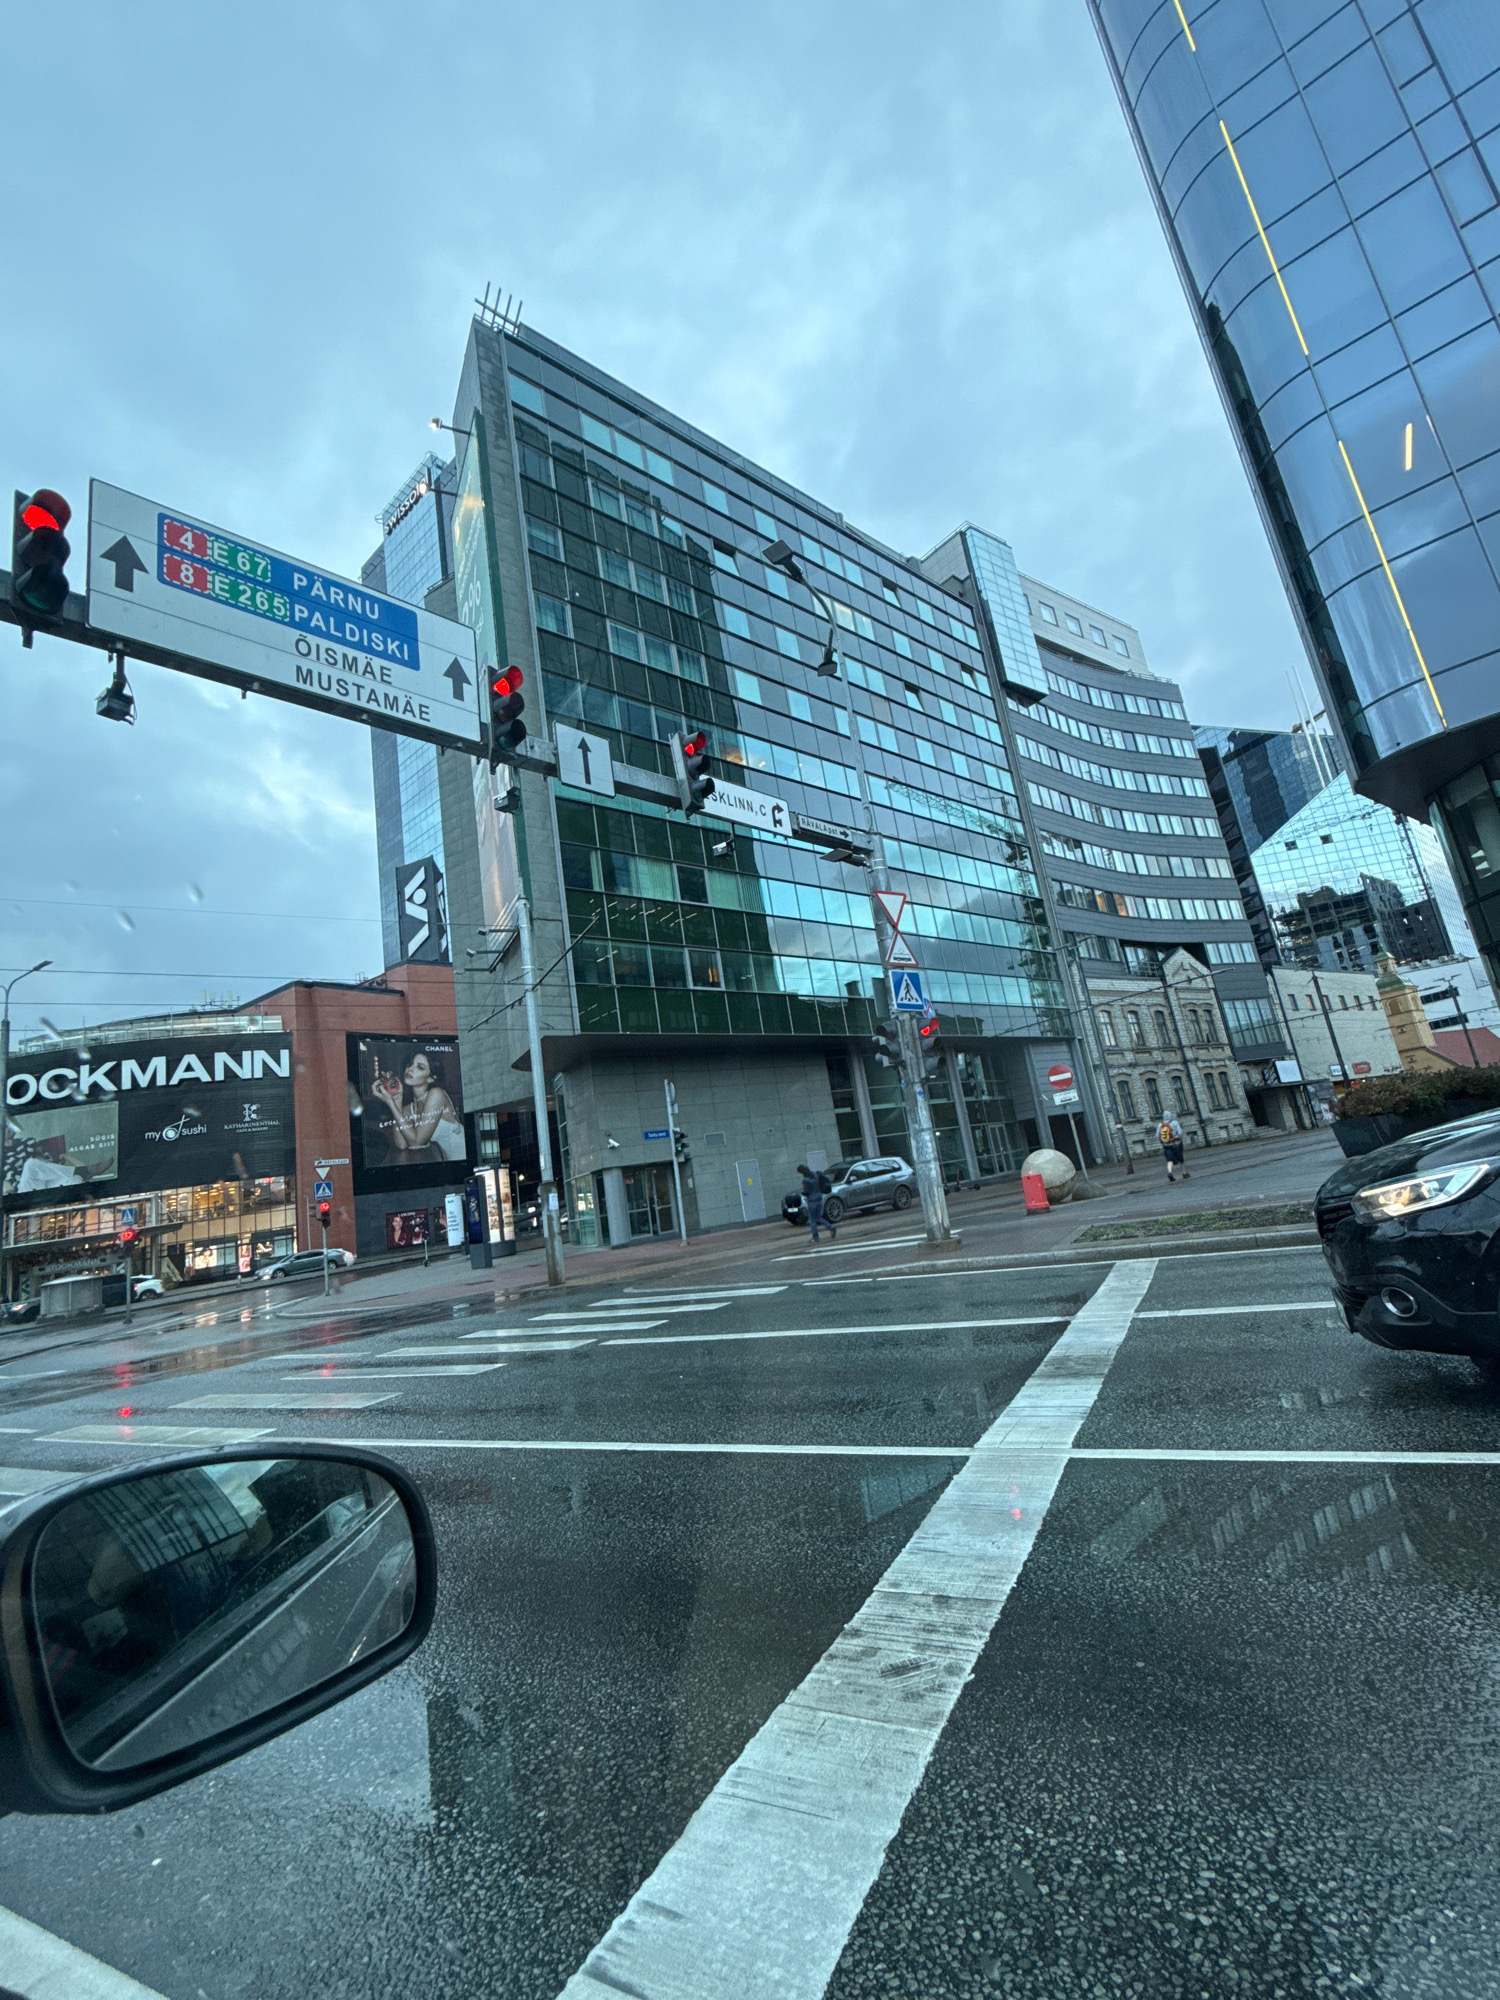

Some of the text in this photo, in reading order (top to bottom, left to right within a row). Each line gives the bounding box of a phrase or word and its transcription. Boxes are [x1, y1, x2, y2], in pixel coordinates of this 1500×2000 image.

[179, 531, 267, 576] 4 E 67
[180, 564, 286, 616] 8 E 265
[293, 571, 379, 619] PÄRNU
[294, 603, 409, 661] PALDISKI
[294, 633, 393, 685] ÕISMÄE
[295, 664, 431, 722] MUSTAMÄE
[69, 1141, 116, 1152] ALGAB SIIT
[89, 1133, 115, 1142] SÜGIS
[145, 1124, 207, 1142] my sushi
